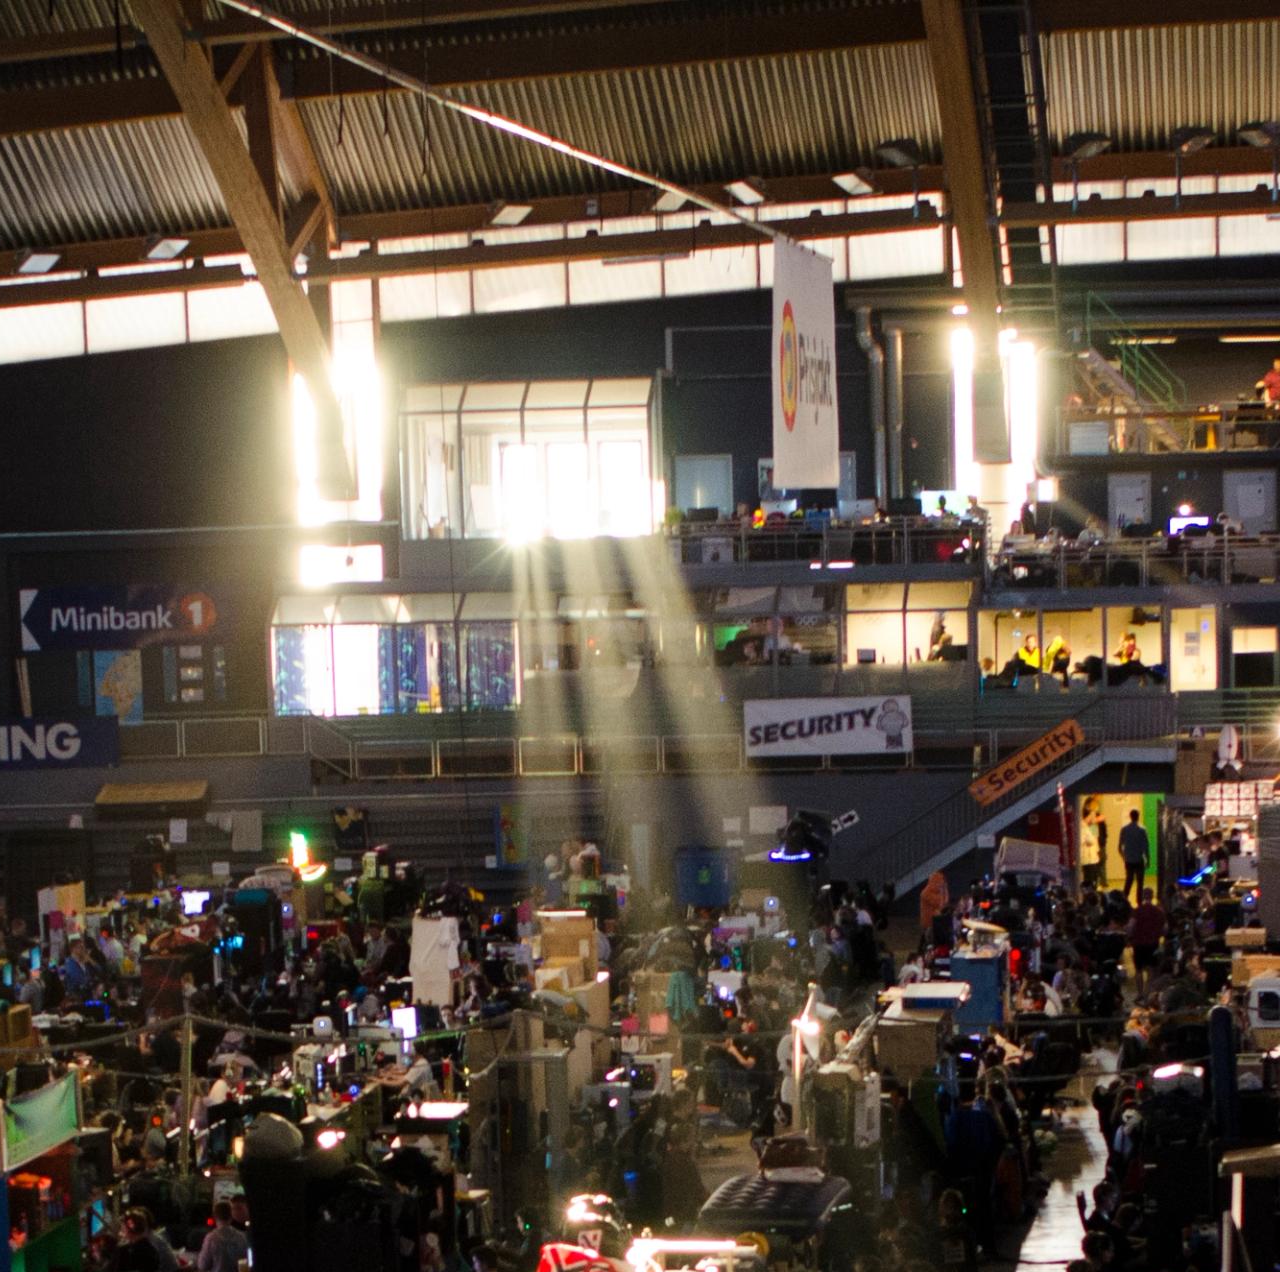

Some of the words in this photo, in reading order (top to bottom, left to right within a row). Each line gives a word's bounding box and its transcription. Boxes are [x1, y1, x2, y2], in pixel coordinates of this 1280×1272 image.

[51, 604, 173, 632] Minibank
[749, 706, 877, 746] SECURITY
[988, 725, 1076, 791] Security
